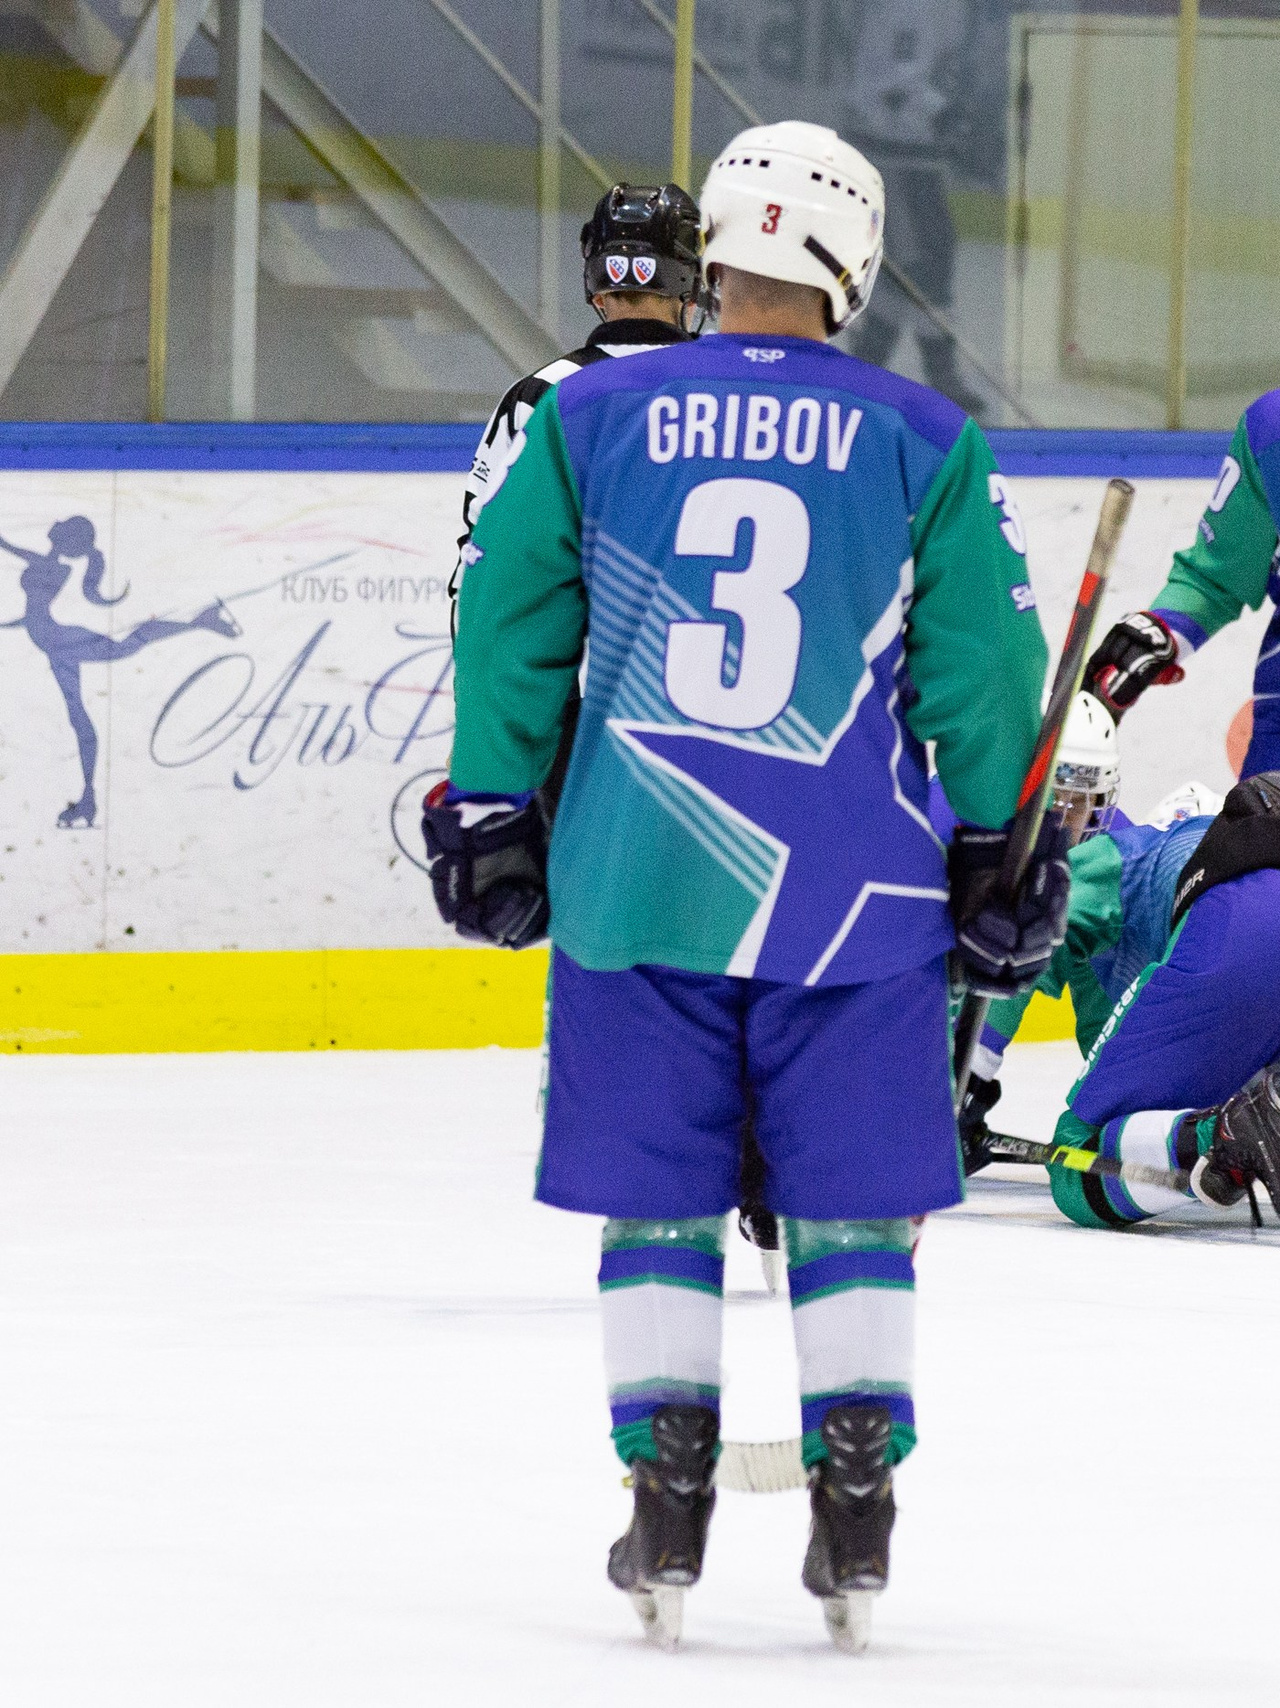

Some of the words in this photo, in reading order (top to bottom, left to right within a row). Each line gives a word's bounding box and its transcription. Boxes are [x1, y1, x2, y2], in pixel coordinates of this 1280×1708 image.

[761, 203, 783, 235] 3
[648, 392, 863, 472] GRIBOV
[281, 575, 349, 602] КЛУБ
[664, 478, 812, 730] 3
